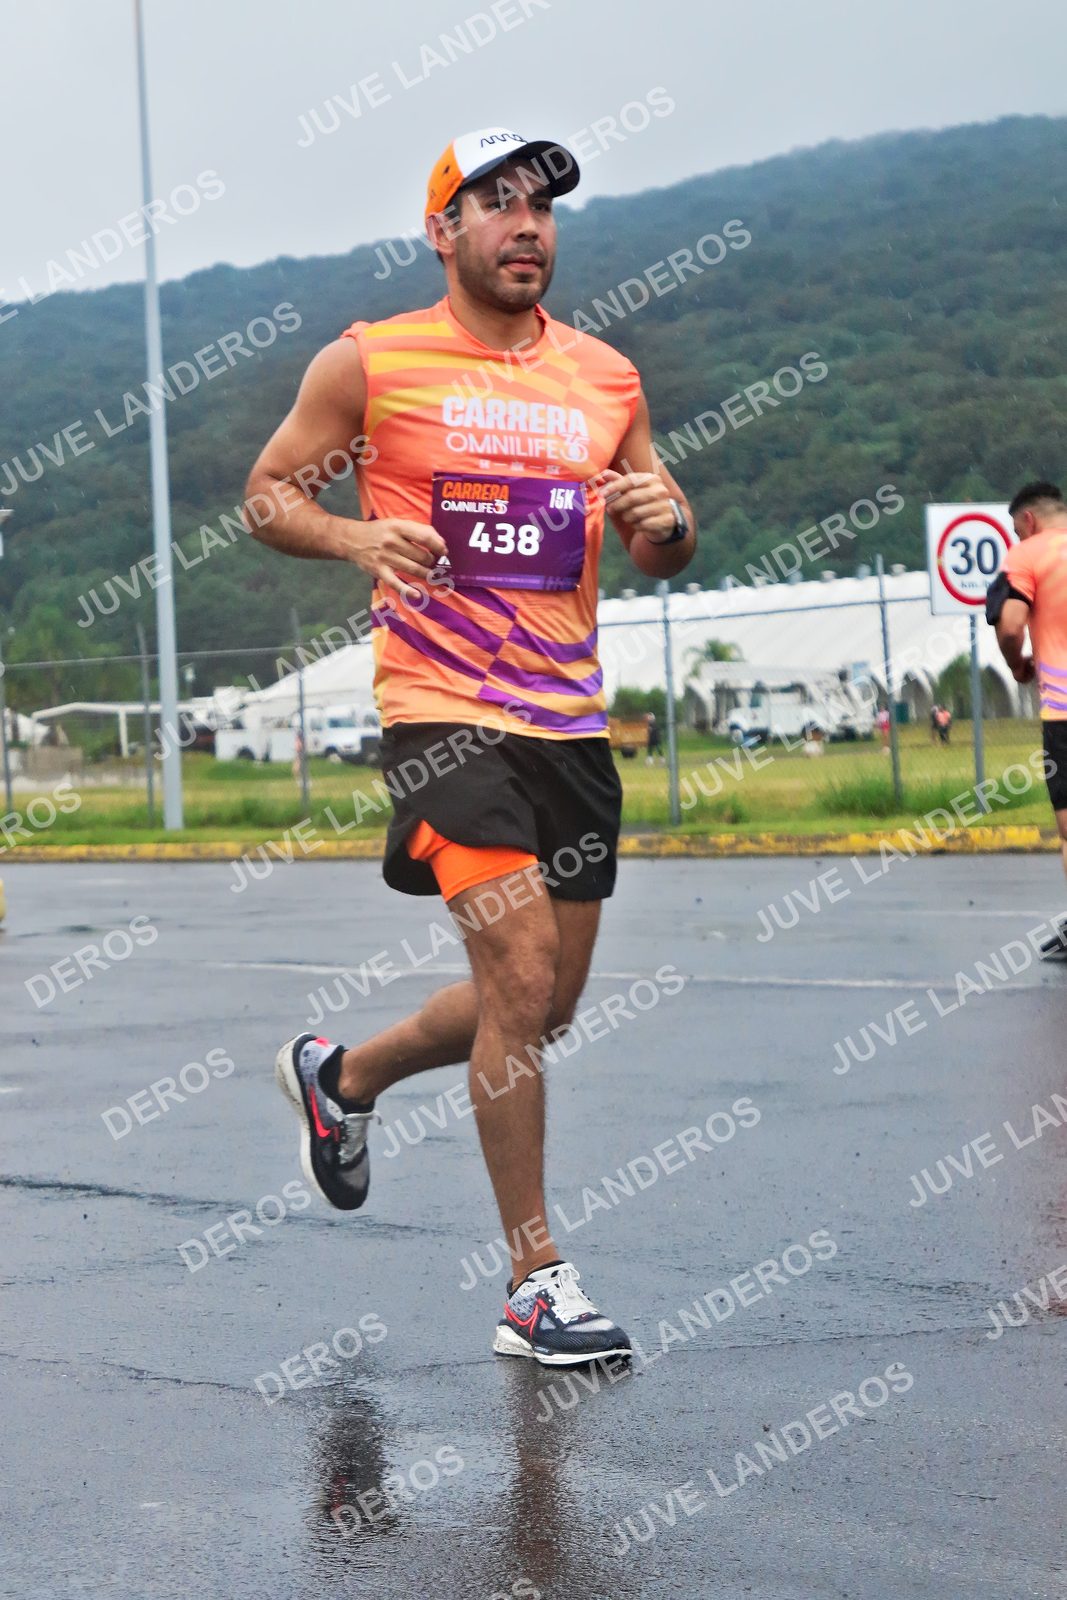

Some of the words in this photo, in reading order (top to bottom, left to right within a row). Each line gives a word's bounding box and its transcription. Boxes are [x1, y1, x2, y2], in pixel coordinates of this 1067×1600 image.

[442, 395, 588, 436] CARRERA
[441, 481, 509, 501] CARRERA
[549, 487, 575, 511] 15K
[468, 522, 540, 556] 438
[951, 537, 999, 575] 30
